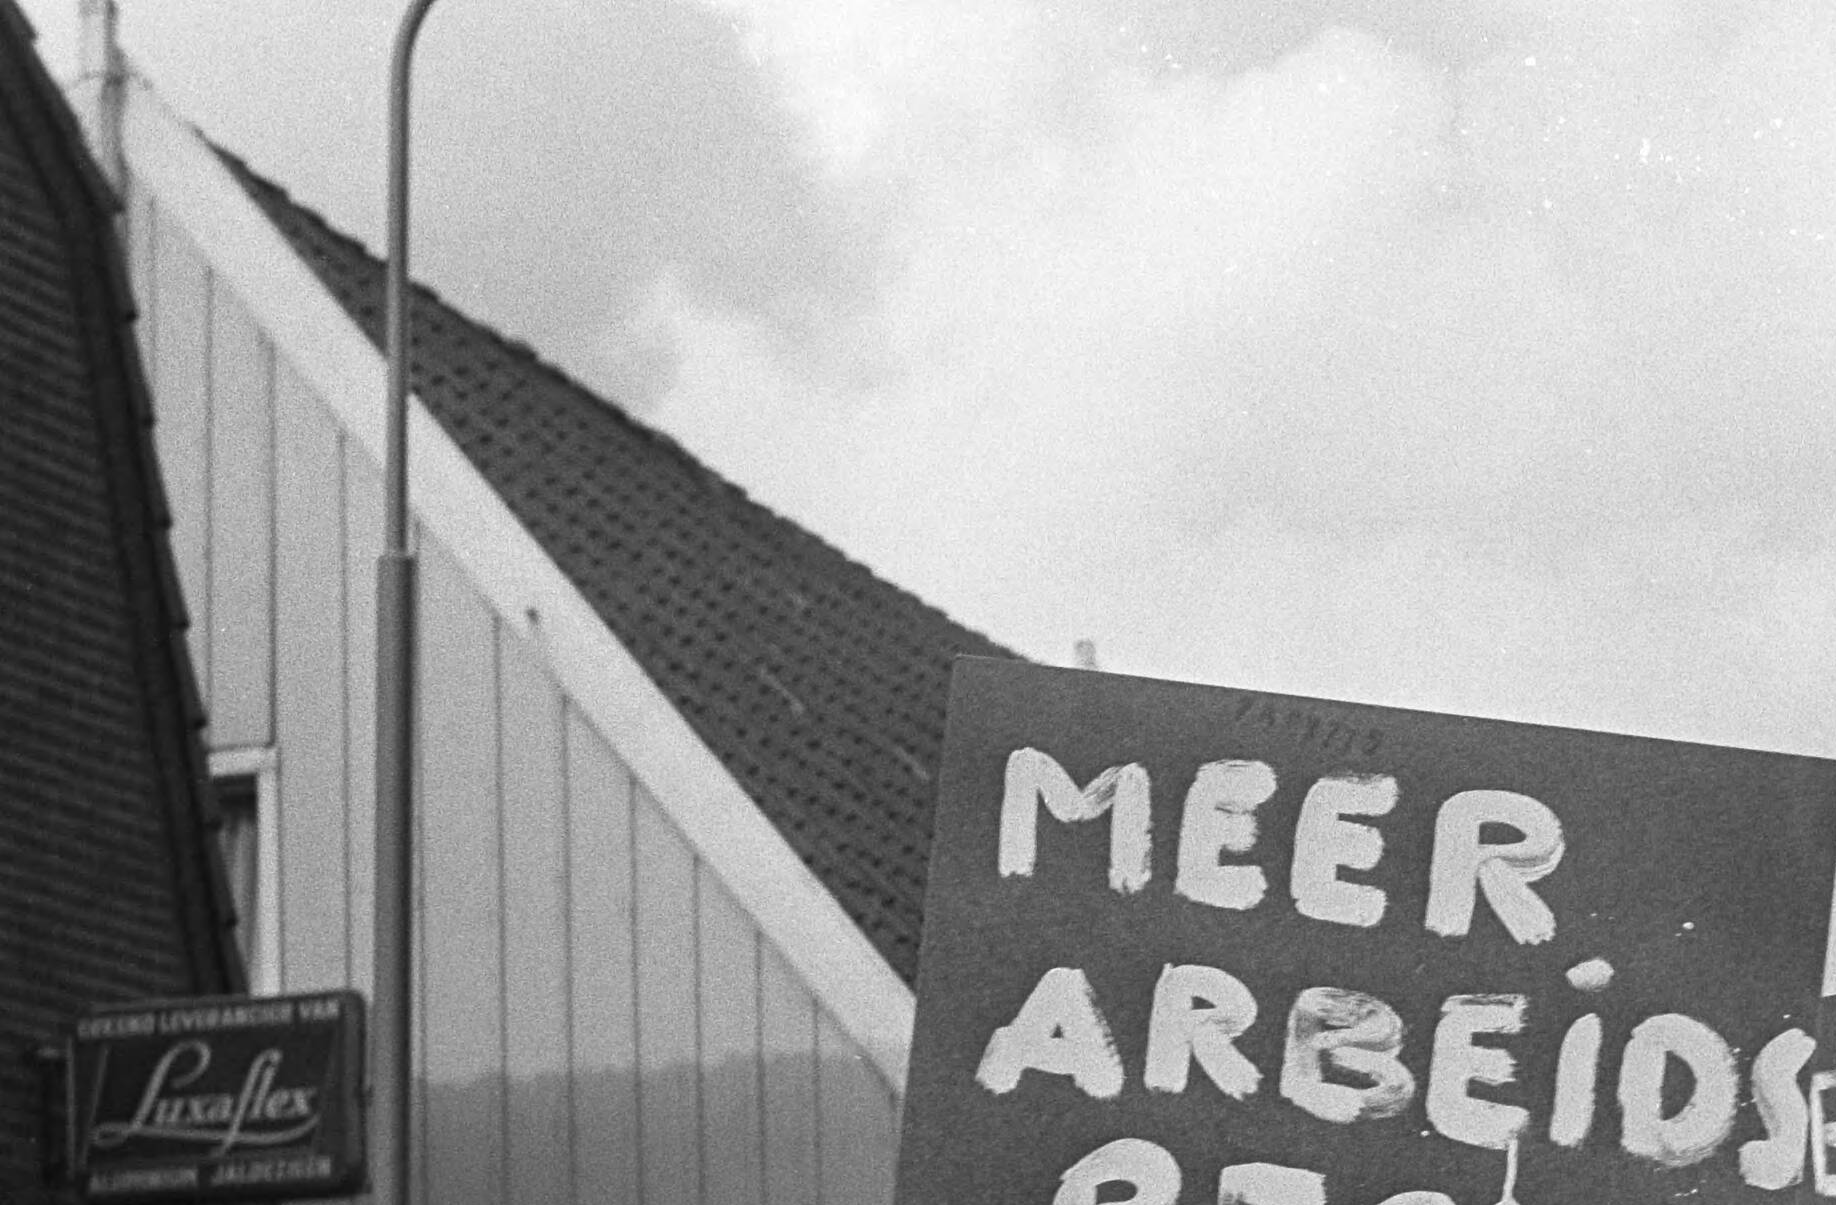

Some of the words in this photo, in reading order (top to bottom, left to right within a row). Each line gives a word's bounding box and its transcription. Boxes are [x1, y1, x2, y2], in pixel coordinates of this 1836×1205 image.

[999, 746, 1566, 944] MEER
[93, 1039, 320, 1157] Luxaflex
[976, 958, 1817, 1190] ARBEIDS
